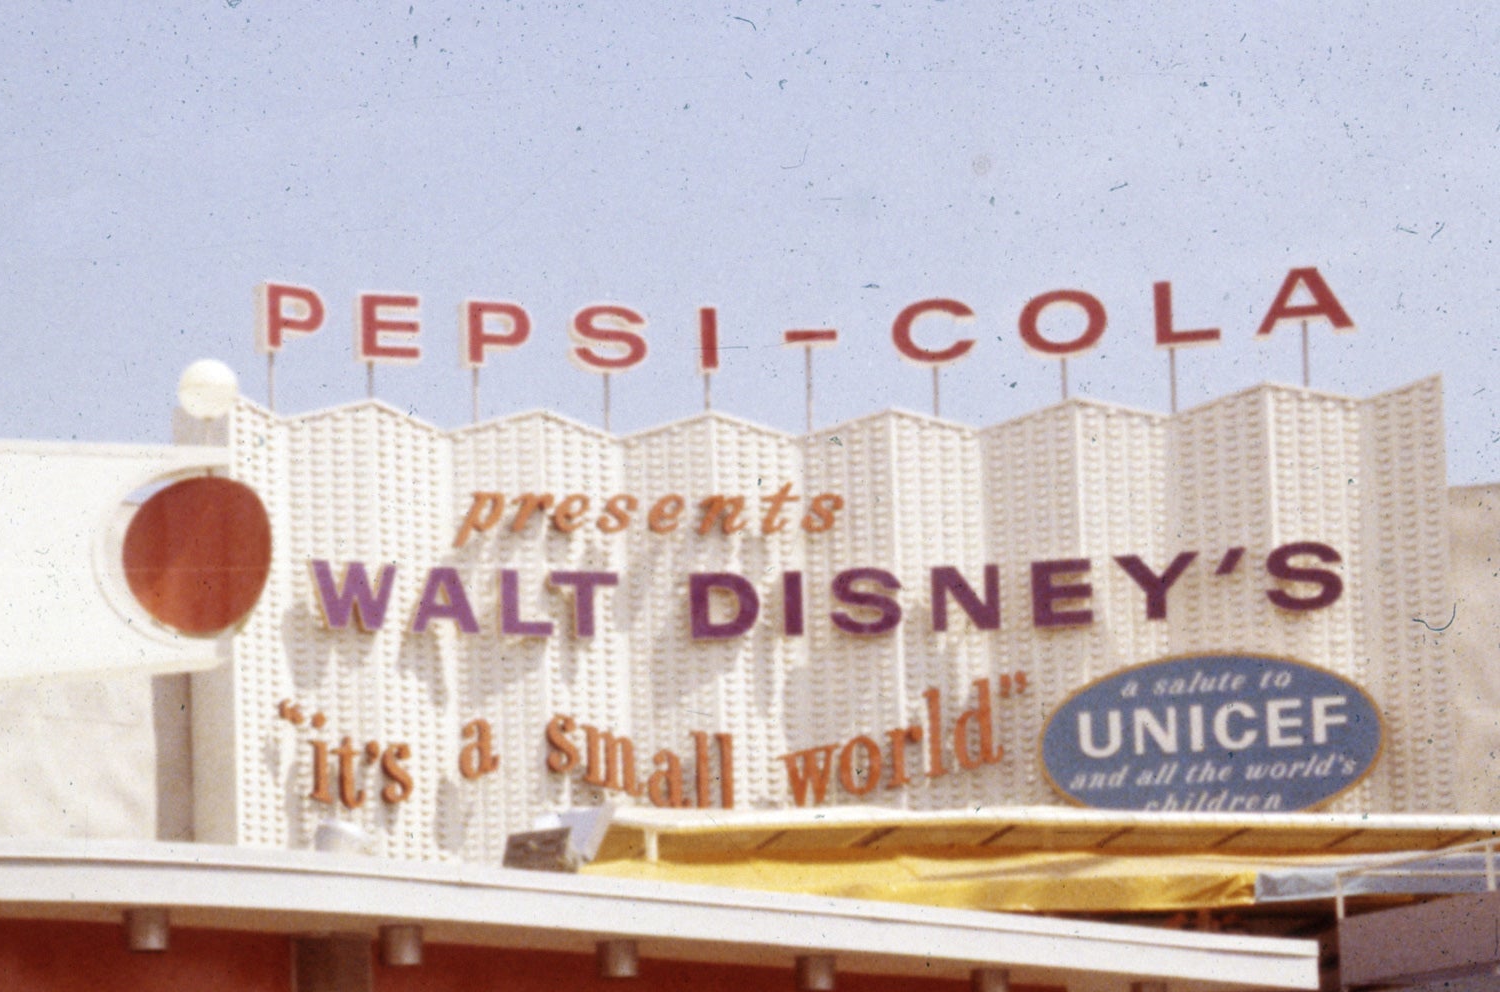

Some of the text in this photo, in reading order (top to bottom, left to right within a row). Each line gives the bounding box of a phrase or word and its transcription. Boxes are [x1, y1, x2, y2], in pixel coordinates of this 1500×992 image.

[264, 266, 1355, 370] PEPSI-COLA
[452, 481, 844, 549] presents
[311, 541, 1346, 645] WALT DISNEY'S
[1120, 669, 1293, 698] a salute to
[278, 673, 1028, 810] "it's a small world"
[1077, 694, 1349, 758] UNICEF
[1068, 753, 1358, 791] and all the world's
